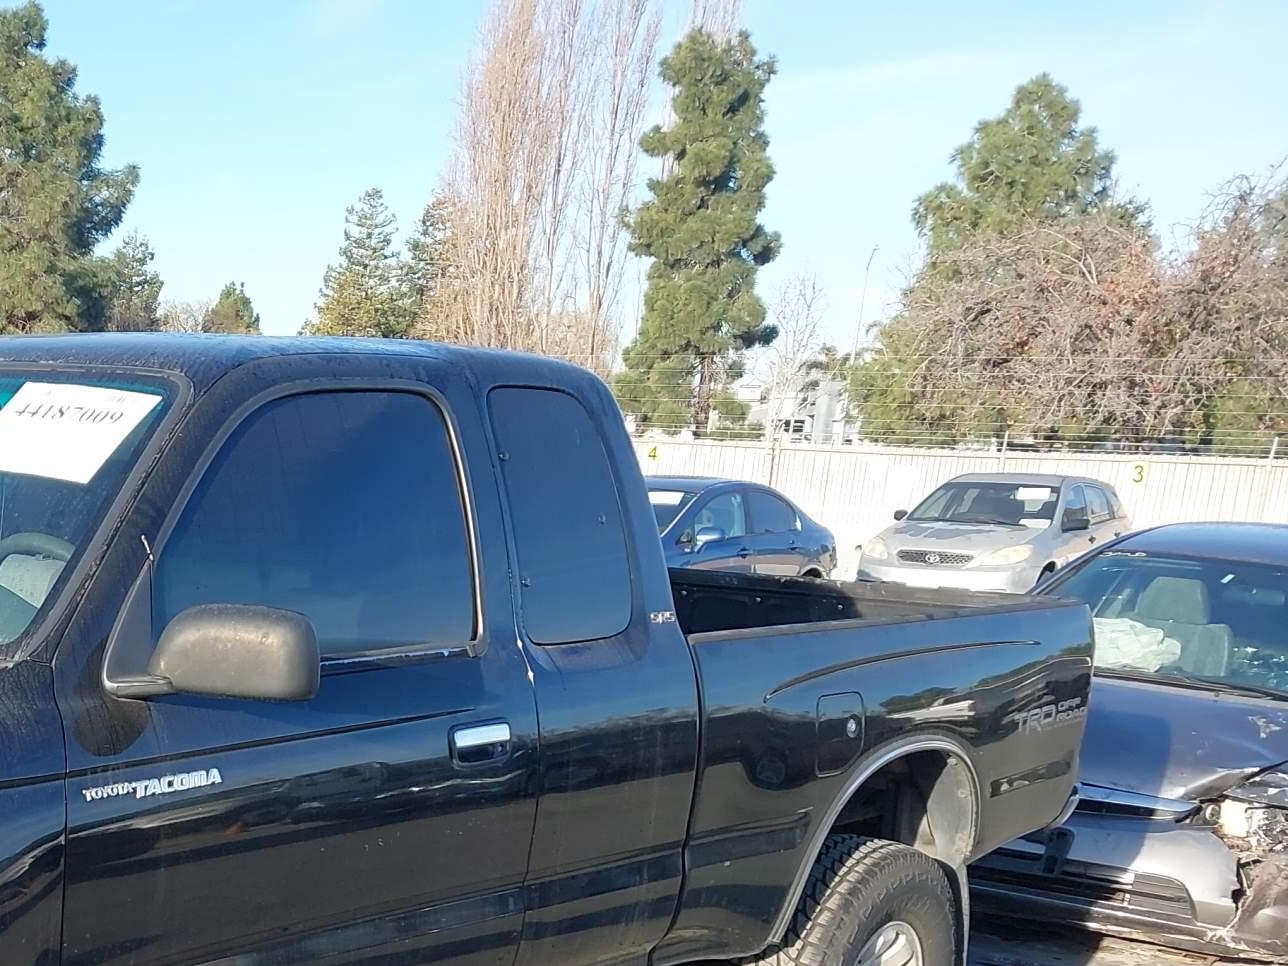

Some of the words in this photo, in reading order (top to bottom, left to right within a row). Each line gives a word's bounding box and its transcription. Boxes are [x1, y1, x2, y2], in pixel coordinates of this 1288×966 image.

[15, 402, 124, 424] 44187009
[648, 444, 658, 461] 4
[1132, 465, 1145, 483] 3
[650, 611, 675, 625] SR5
[1014, 703, 1056, 734] TRD
[82, 782, 132, 801] TOYOTA
[134, 768, 222, 799] TACOMA
